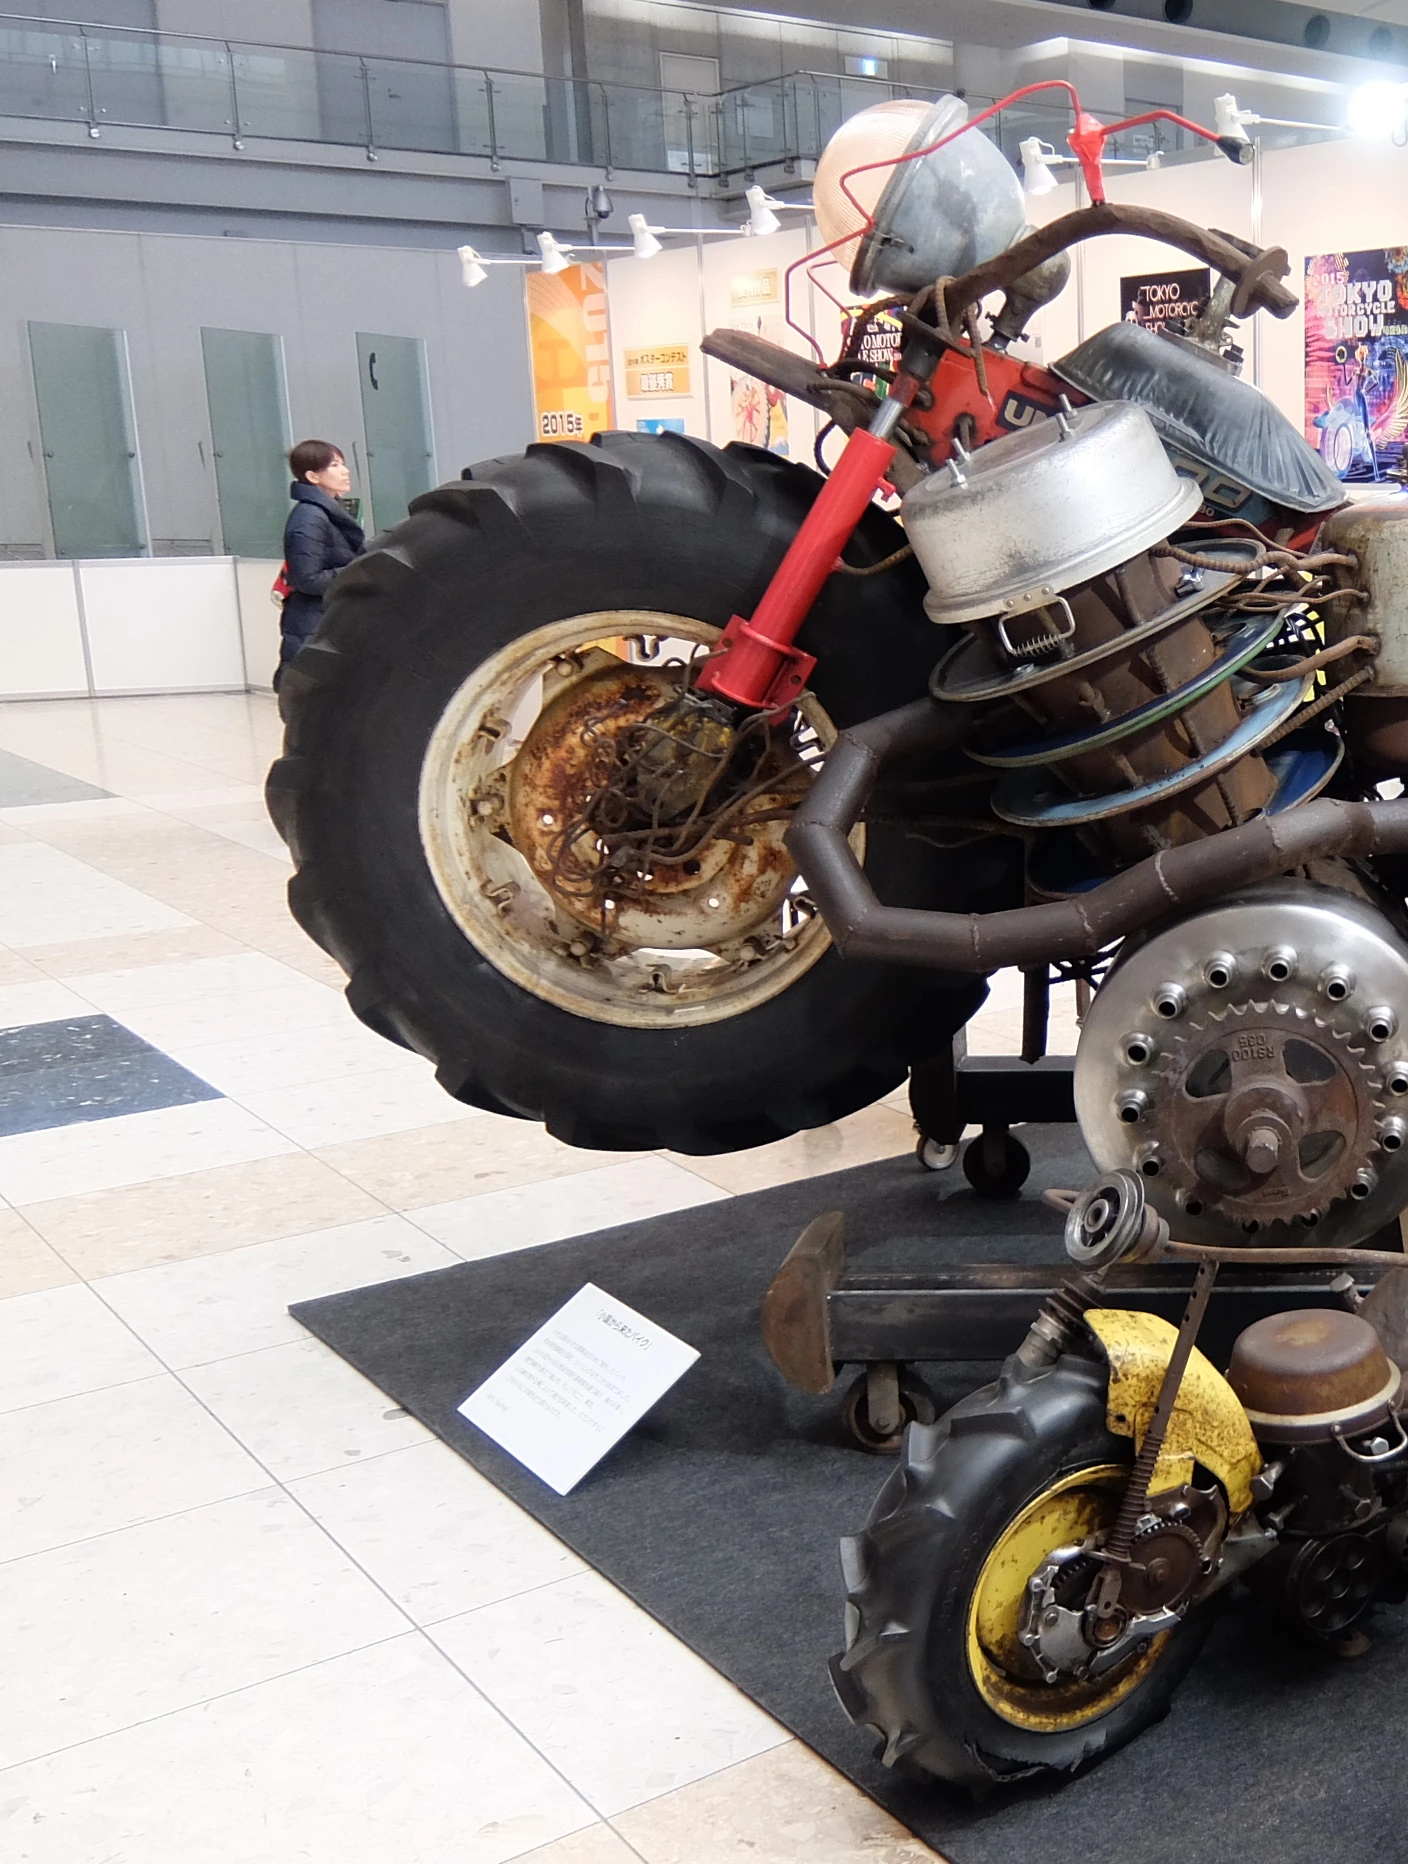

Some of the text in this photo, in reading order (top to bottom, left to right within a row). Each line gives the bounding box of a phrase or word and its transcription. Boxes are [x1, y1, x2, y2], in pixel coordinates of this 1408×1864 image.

[1140, 282, 1180, 302] TOKYO
[1320, 279, 1393, 306] TOKYO
[1143, 300, 1199, 319] MOTORCYC
[1317, 300, 1396, 318] MOTORCYCLE
[1324, 314, 1384, 339] SHOW
[541, 412, 584, 436] 2015年
